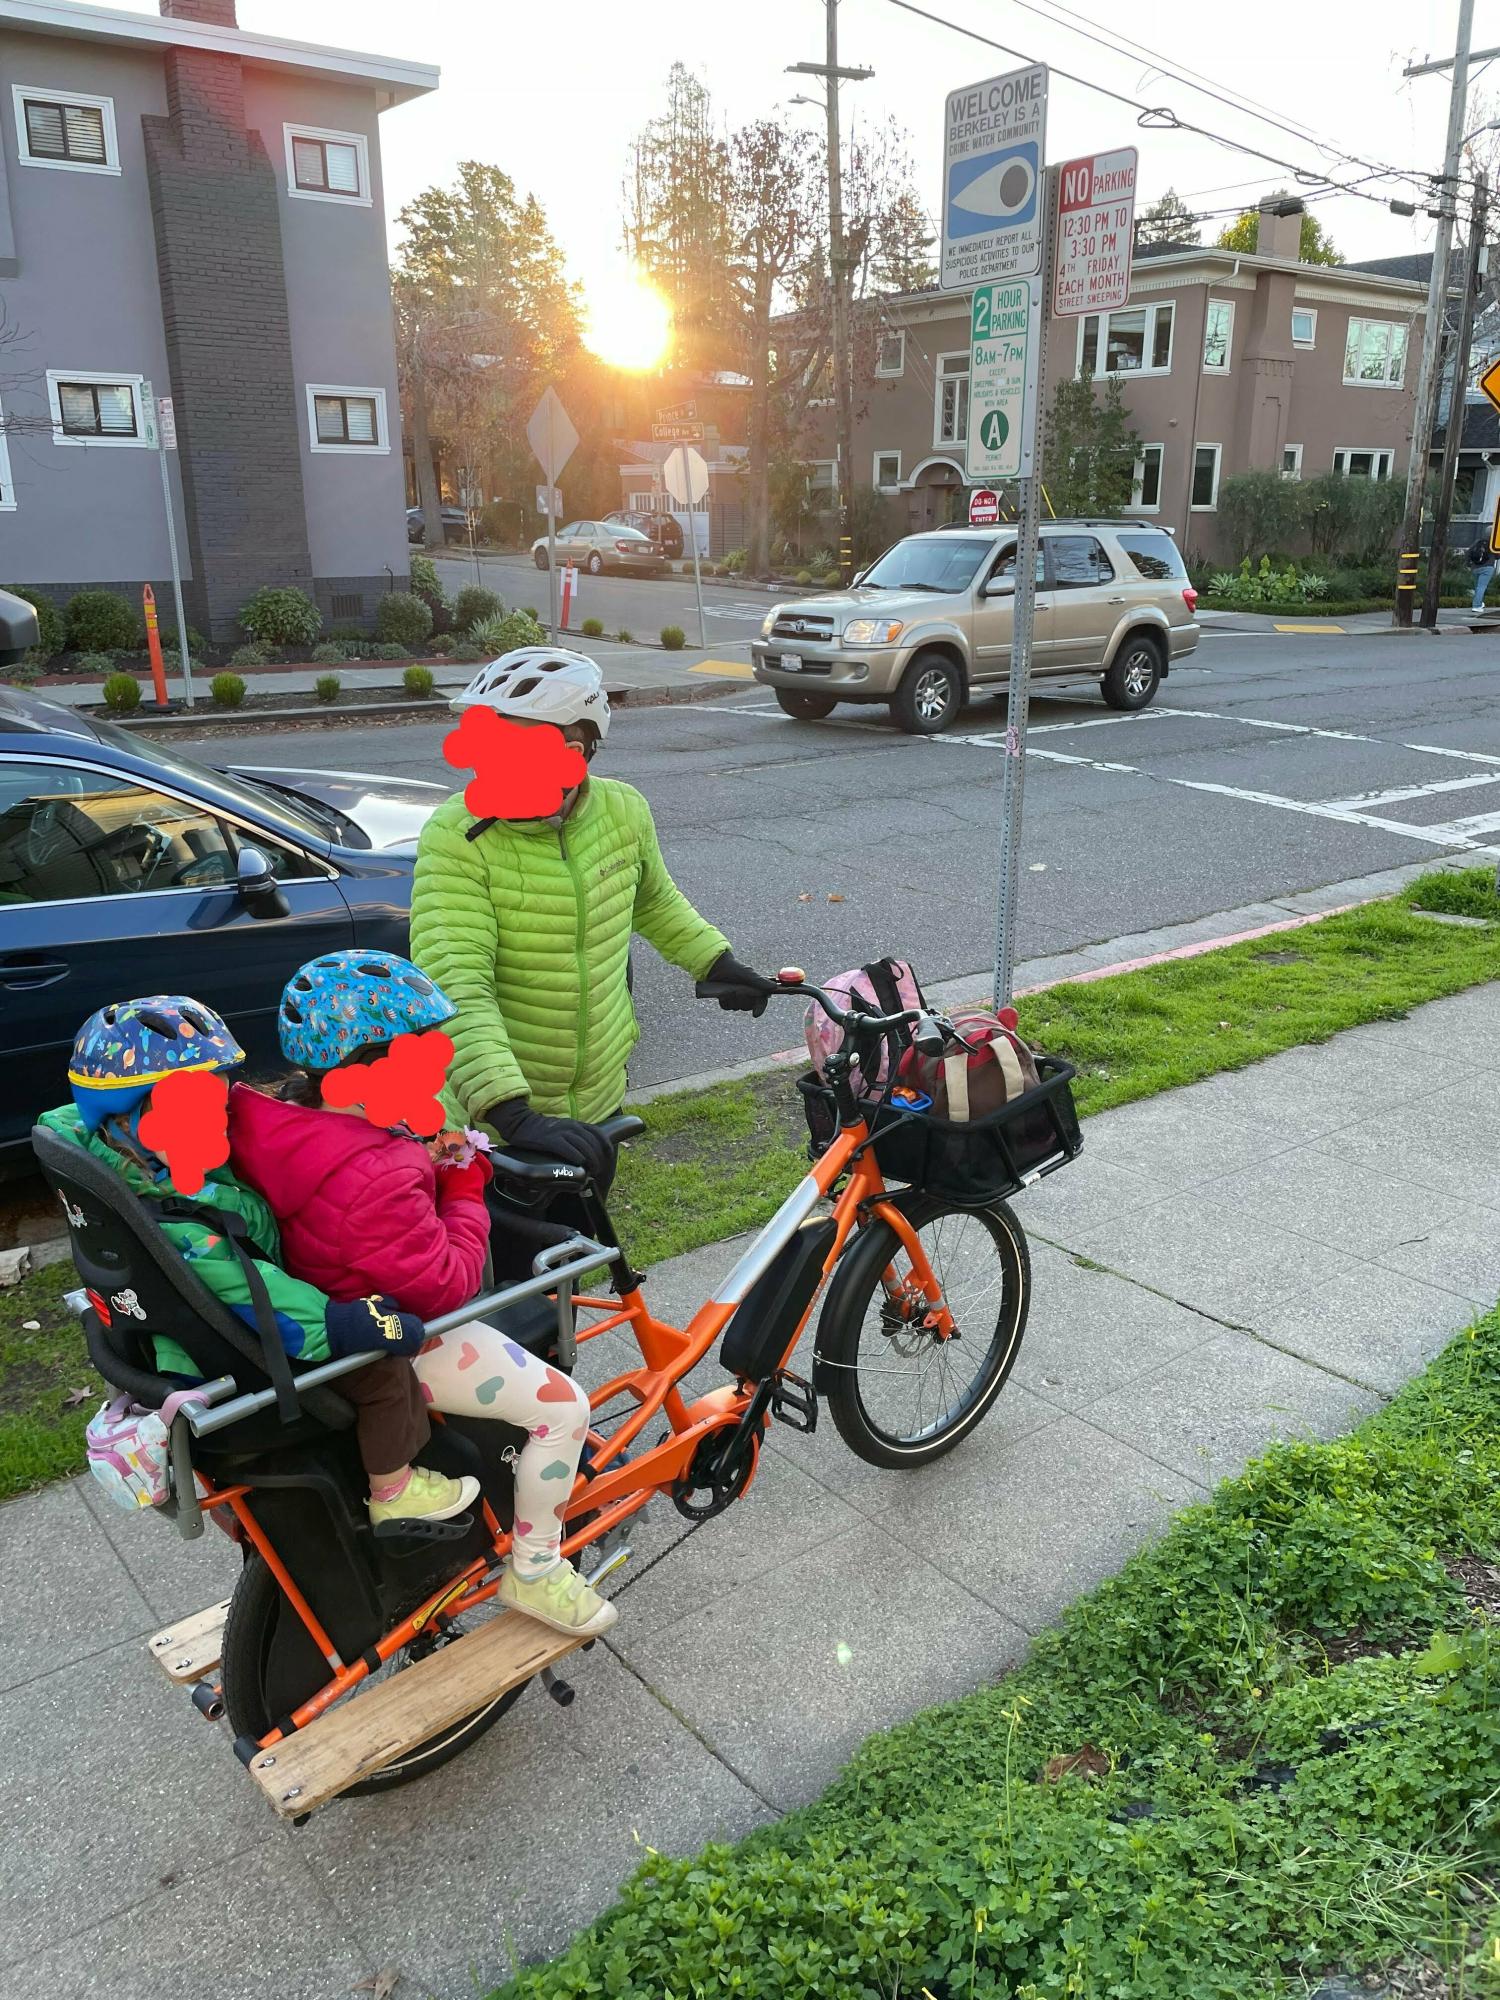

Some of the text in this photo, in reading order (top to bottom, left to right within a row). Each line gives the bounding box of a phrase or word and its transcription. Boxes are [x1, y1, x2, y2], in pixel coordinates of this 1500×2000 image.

[951, 73, 1042, 123] WELCOME
[950, 103, 1040, 141] BERKELEY IS A
[949, 120, 1039, 156] CRIME WATCH COMMUNITY
[1064, 168, 1134, 205] NO PARKING
[1064, 208, 1126, 237] 12:30 PM TO
[946, 243, 1034, 270] SUSPICIOUS ACTIVITIES TO OUR
[948, 231, 1032, 256] WE IMMEDIATELY REPORT ALL
[1071, 232, 1116, 259] 3:30 PM
[959, 259, 1017, 279] POLICE DEPARTMENT
[1060, 255, 1120, 277] 4TH FRIDAY
[1059, 272, 1124, 295] EACH MONTH
[998, 289, 1022, 309] HOUR
[1059, 290, 1122, 309] STREET SWEEPING
[975, 296, 990, 333] 2
[992, 310, 1026, 331] PARKING
[987, 414, 1001, 447] A
[553, 1166, 573, 1177] yuba
